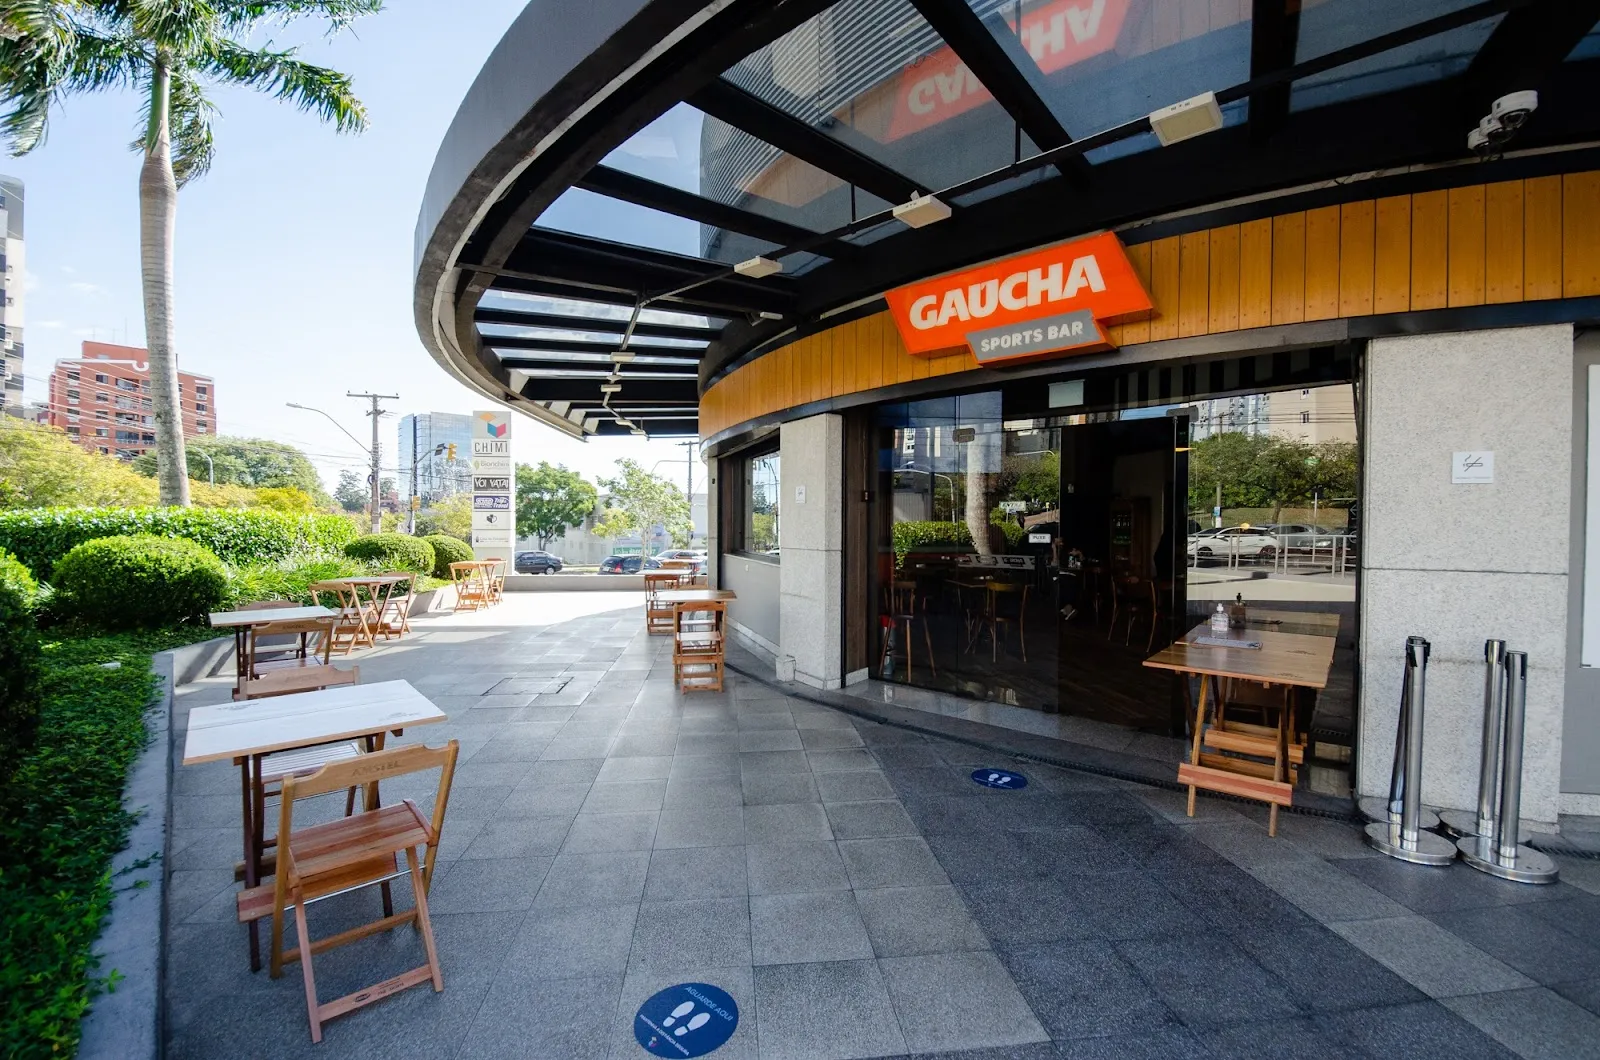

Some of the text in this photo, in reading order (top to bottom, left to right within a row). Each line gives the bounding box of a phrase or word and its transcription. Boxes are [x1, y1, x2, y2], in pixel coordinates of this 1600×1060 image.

[980, 321, 1083, 352] SPORTS BAR
[474, 441, 508, 453] CHIMI
[684, 986, 734, 1021] AGUARDE AQUI
